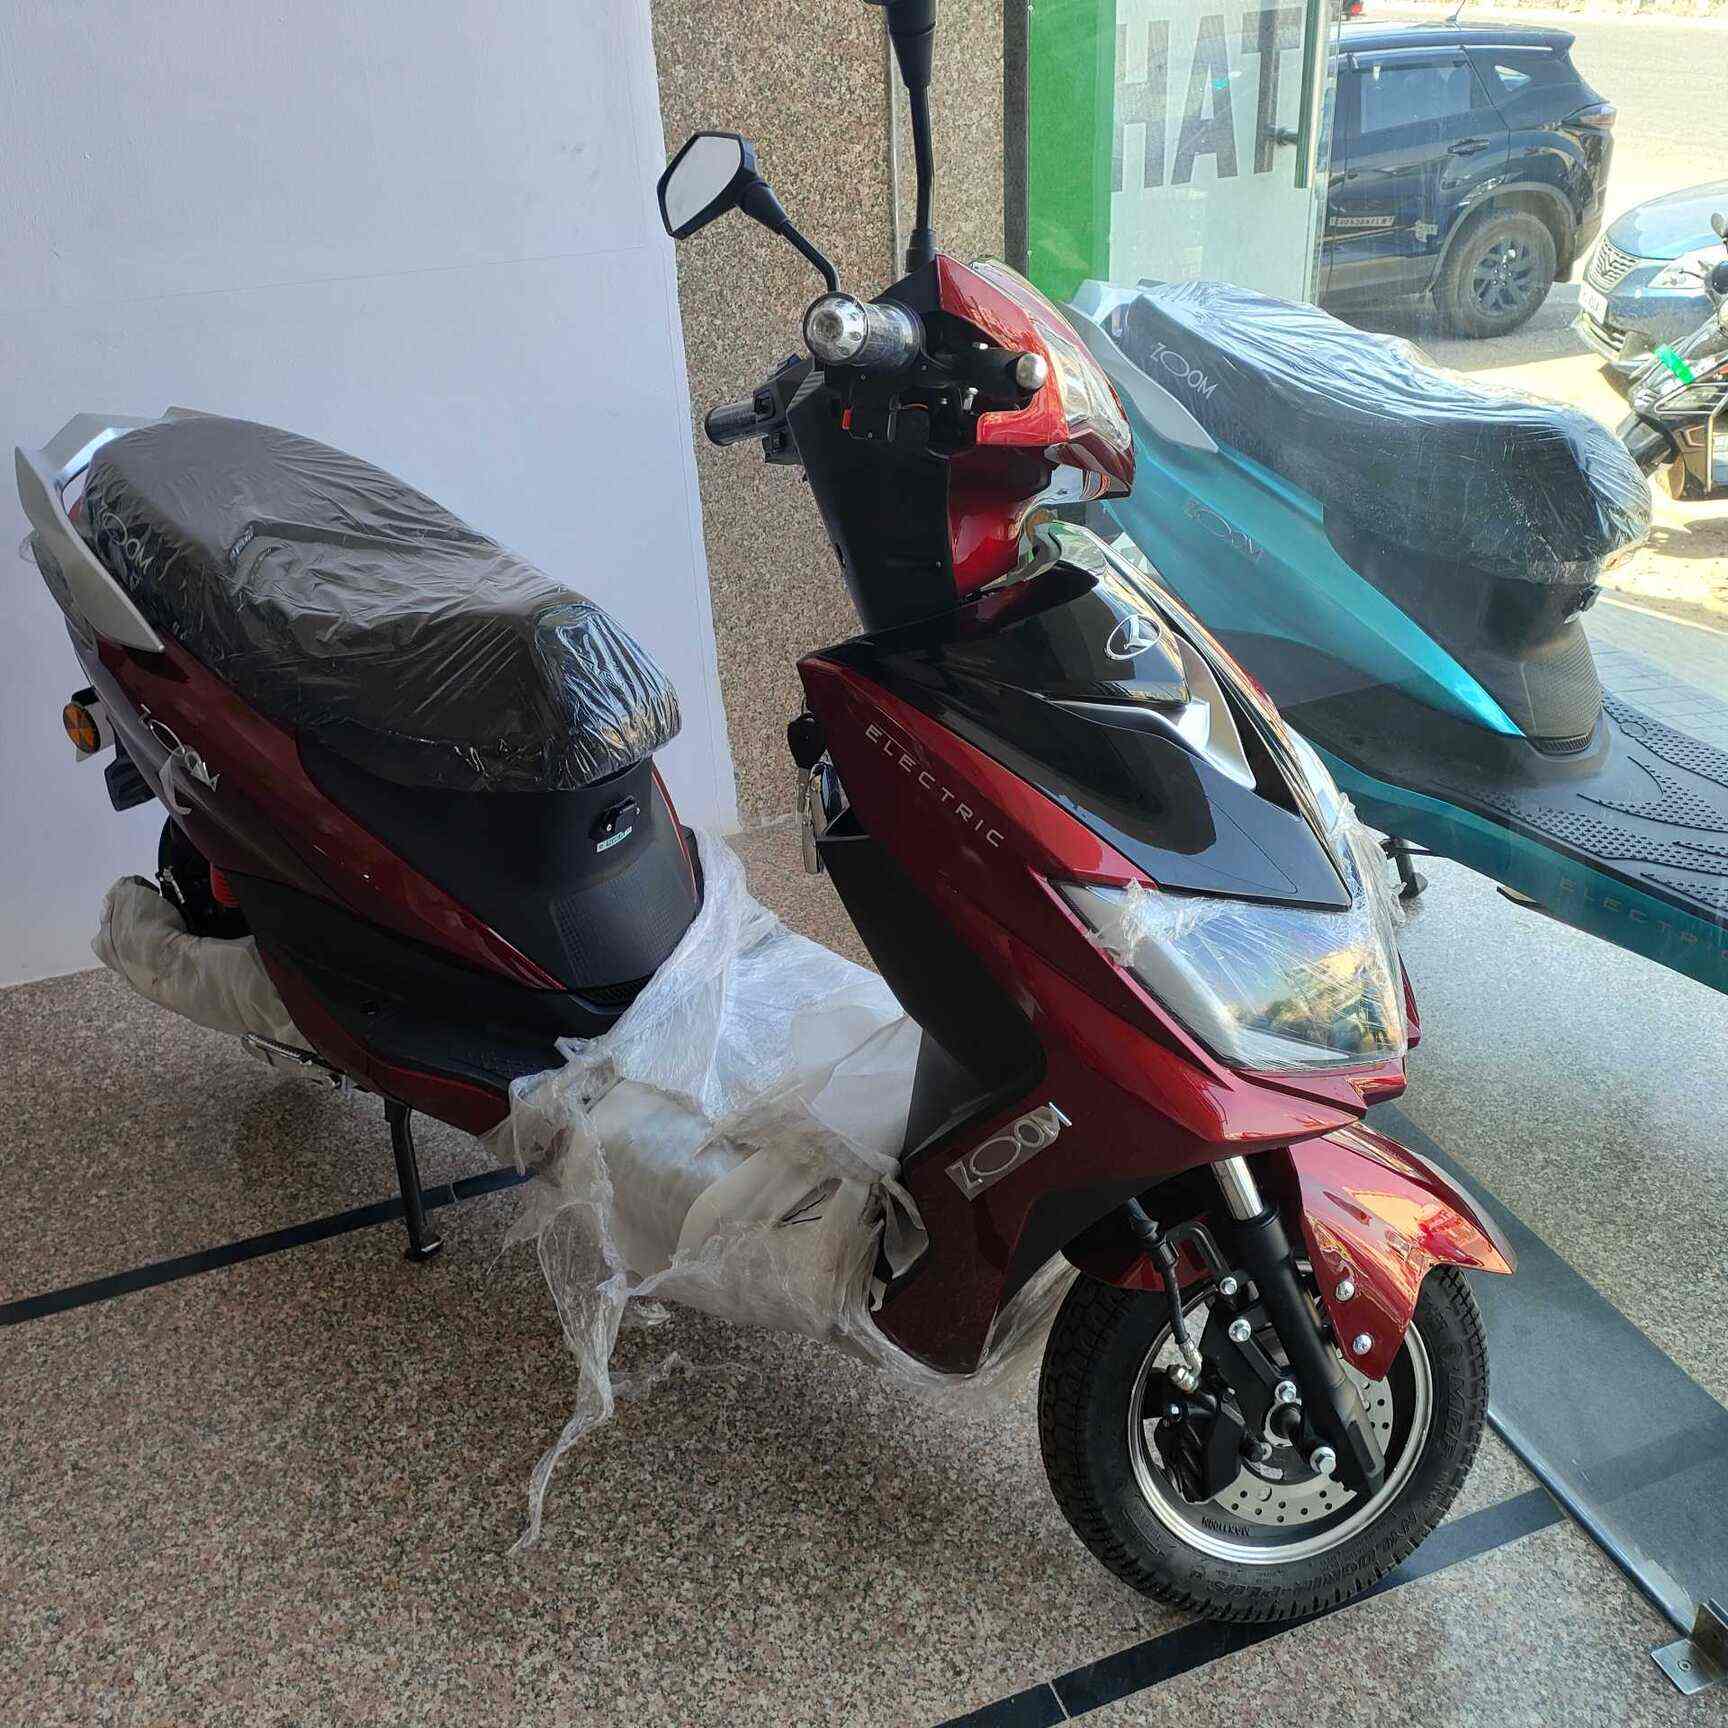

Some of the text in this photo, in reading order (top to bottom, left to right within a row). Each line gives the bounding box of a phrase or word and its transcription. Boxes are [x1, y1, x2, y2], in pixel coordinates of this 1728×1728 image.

[1150, 342, 1218, 399] ZOOM
[865, 723, 1005, 848] ELECTRIC
[950, 1101, 1073, 1190] ZOOM
